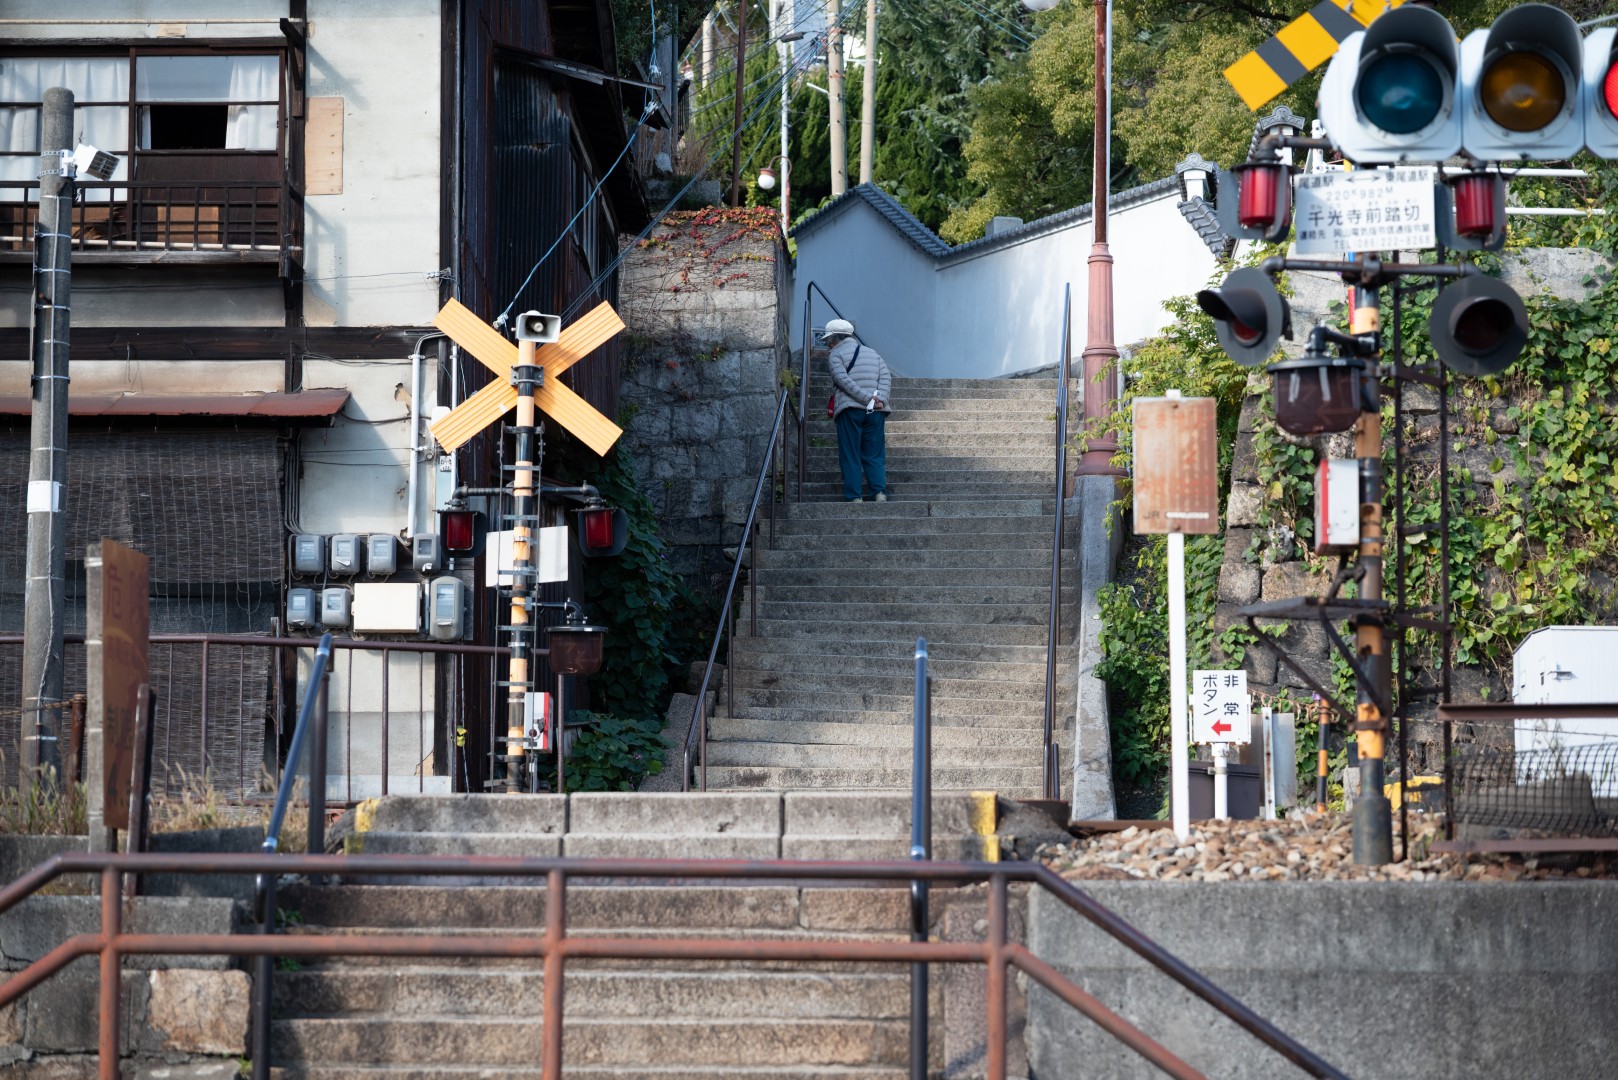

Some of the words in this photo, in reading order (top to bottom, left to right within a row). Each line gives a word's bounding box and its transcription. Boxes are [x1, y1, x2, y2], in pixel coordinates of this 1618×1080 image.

[1308, 205, 1420, 227] 千光寺前踏切
[1203, 675, 1217, 715] ボタン
[1224, 675, 1239, 715] 非常
